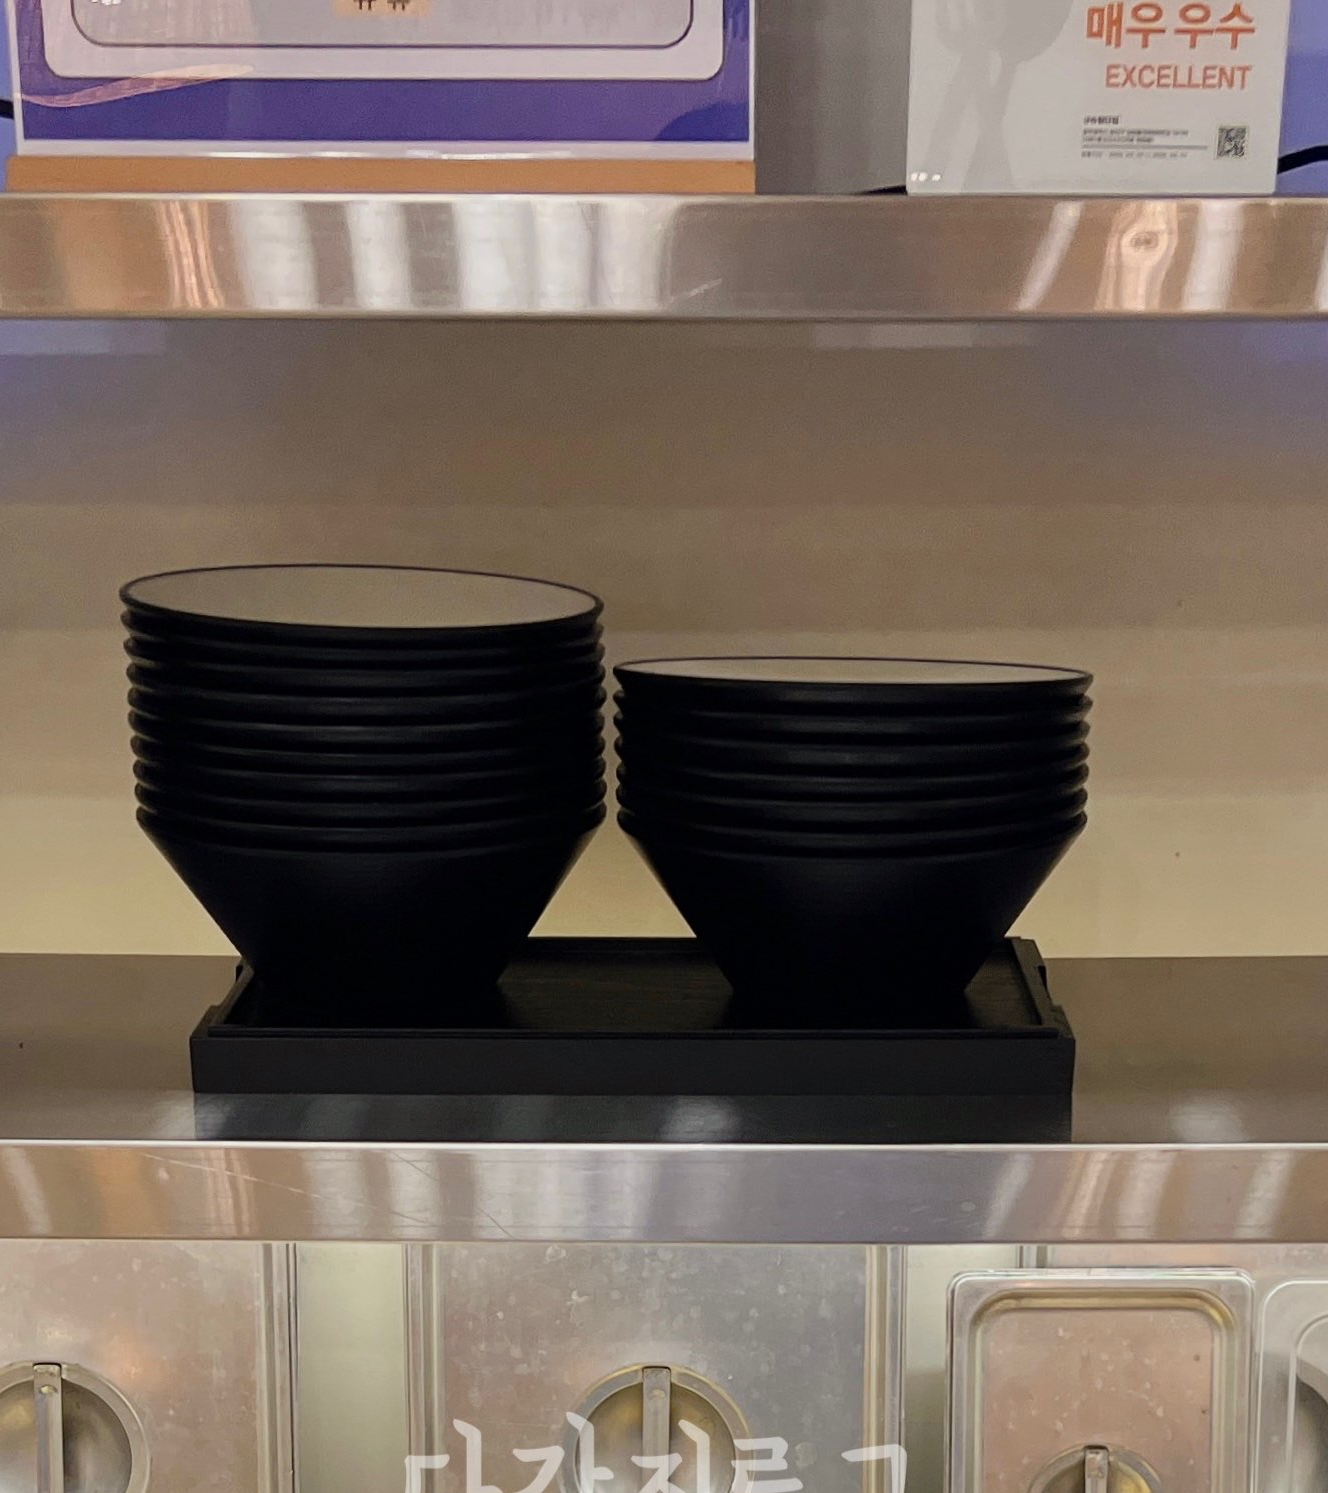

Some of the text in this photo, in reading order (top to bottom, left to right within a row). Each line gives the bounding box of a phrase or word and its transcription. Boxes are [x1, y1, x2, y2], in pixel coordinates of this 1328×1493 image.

[1086, 2, 1255, 50] 매우 우수
[1105, 63, 1252, 90] EXCELLENT
